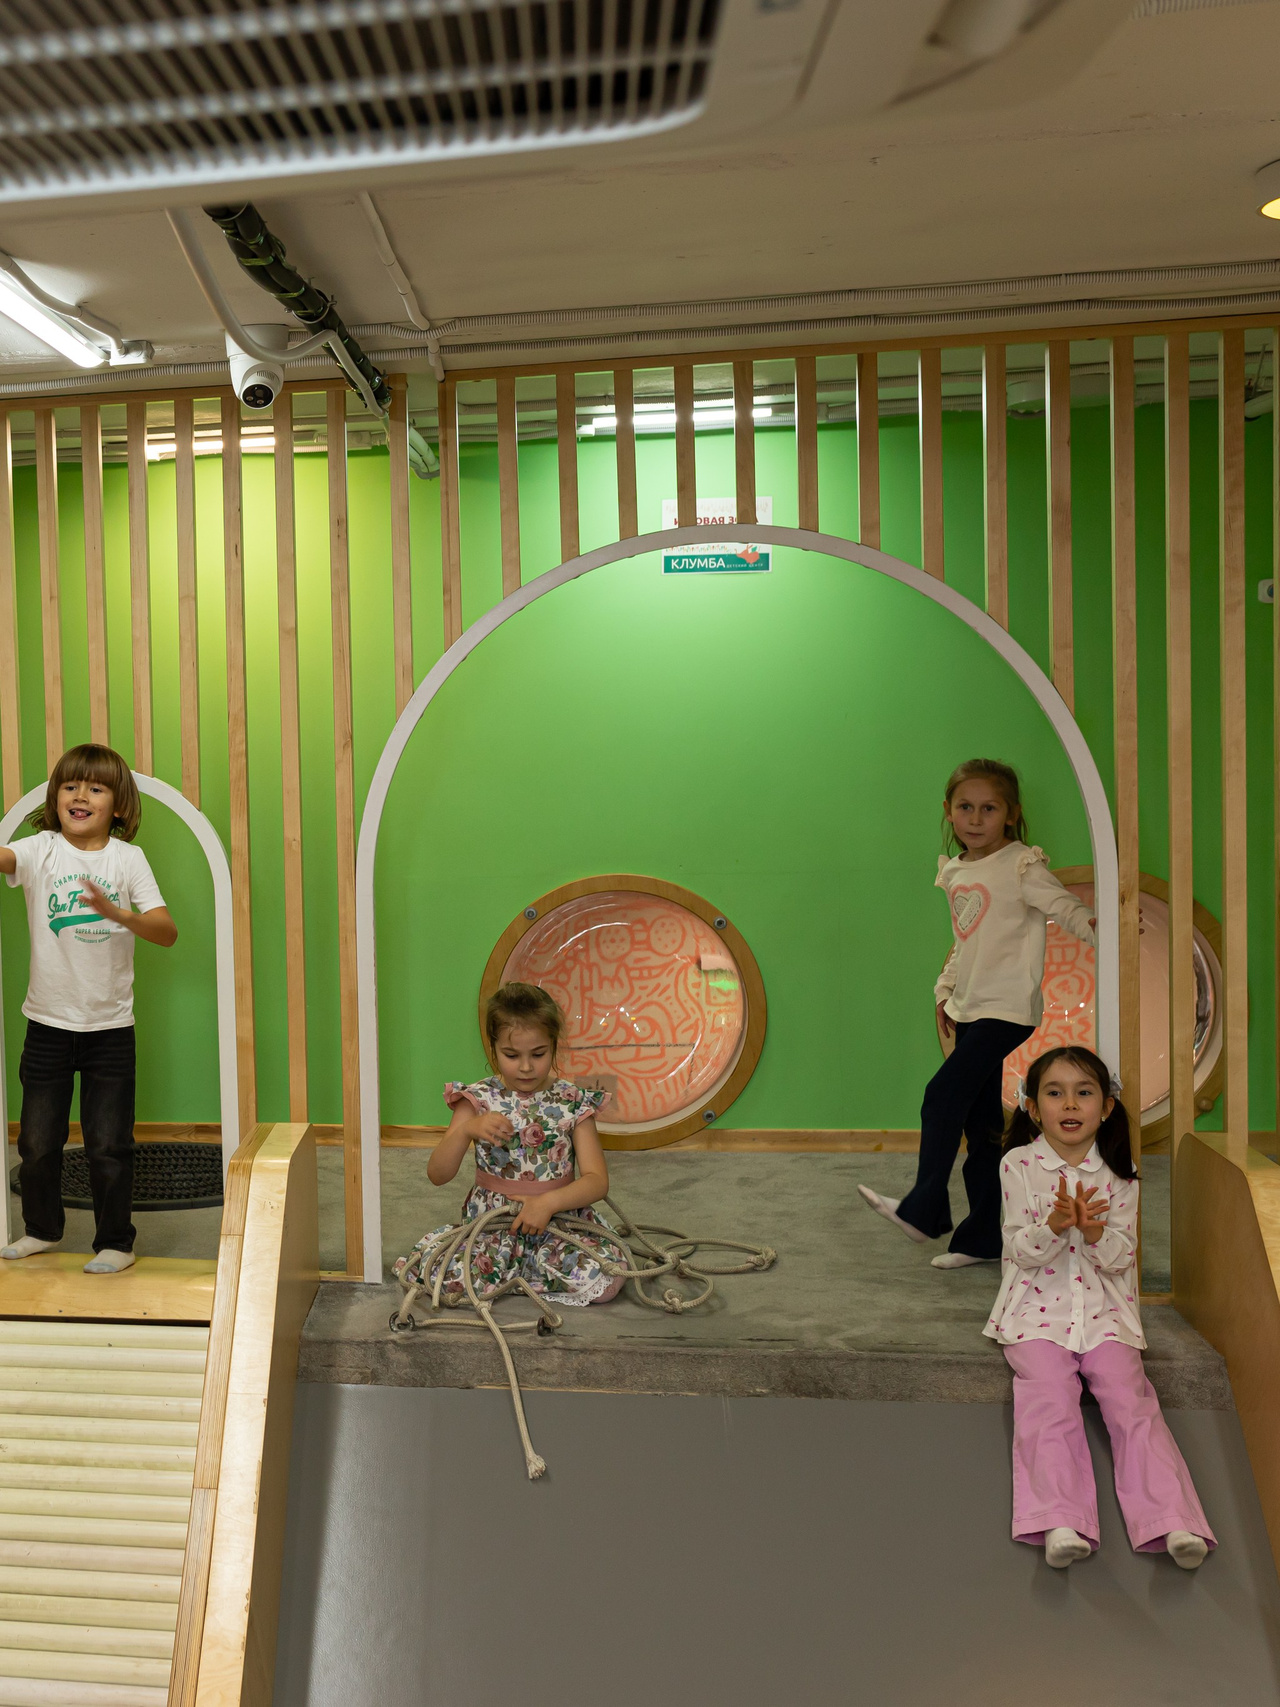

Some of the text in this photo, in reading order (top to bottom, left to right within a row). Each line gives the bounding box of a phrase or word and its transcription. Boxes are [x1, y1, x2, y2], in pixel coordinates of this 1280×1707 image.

[671, 557, 726, 570] КЛУМБА
[53, 873, 112, 890] CHAMPION TEAM
[47, 893, 68, 919] San
